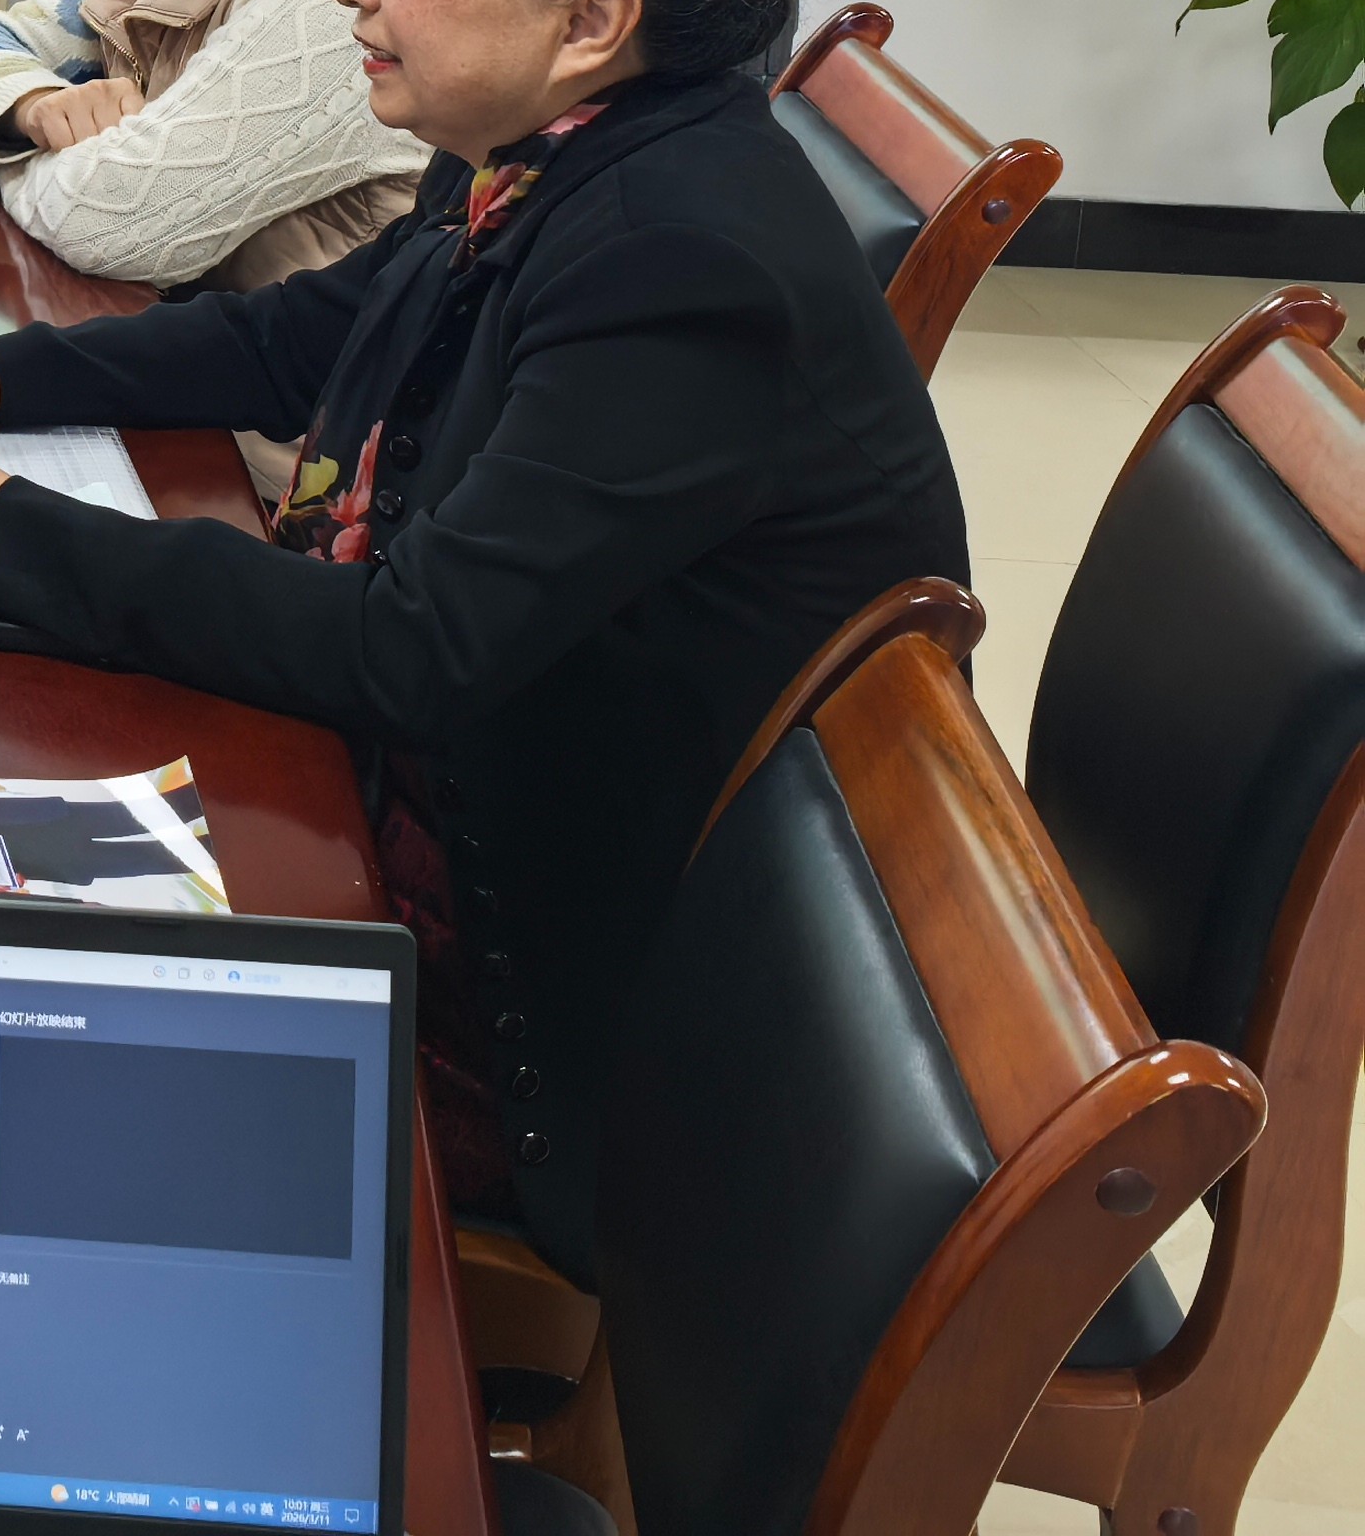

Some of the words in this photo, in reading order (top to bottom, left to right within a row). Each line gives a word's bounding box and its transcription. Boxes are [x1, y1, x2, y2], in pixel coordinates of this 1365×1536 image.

[0, 1010, 87, 1030] 幻灯片放映结束
